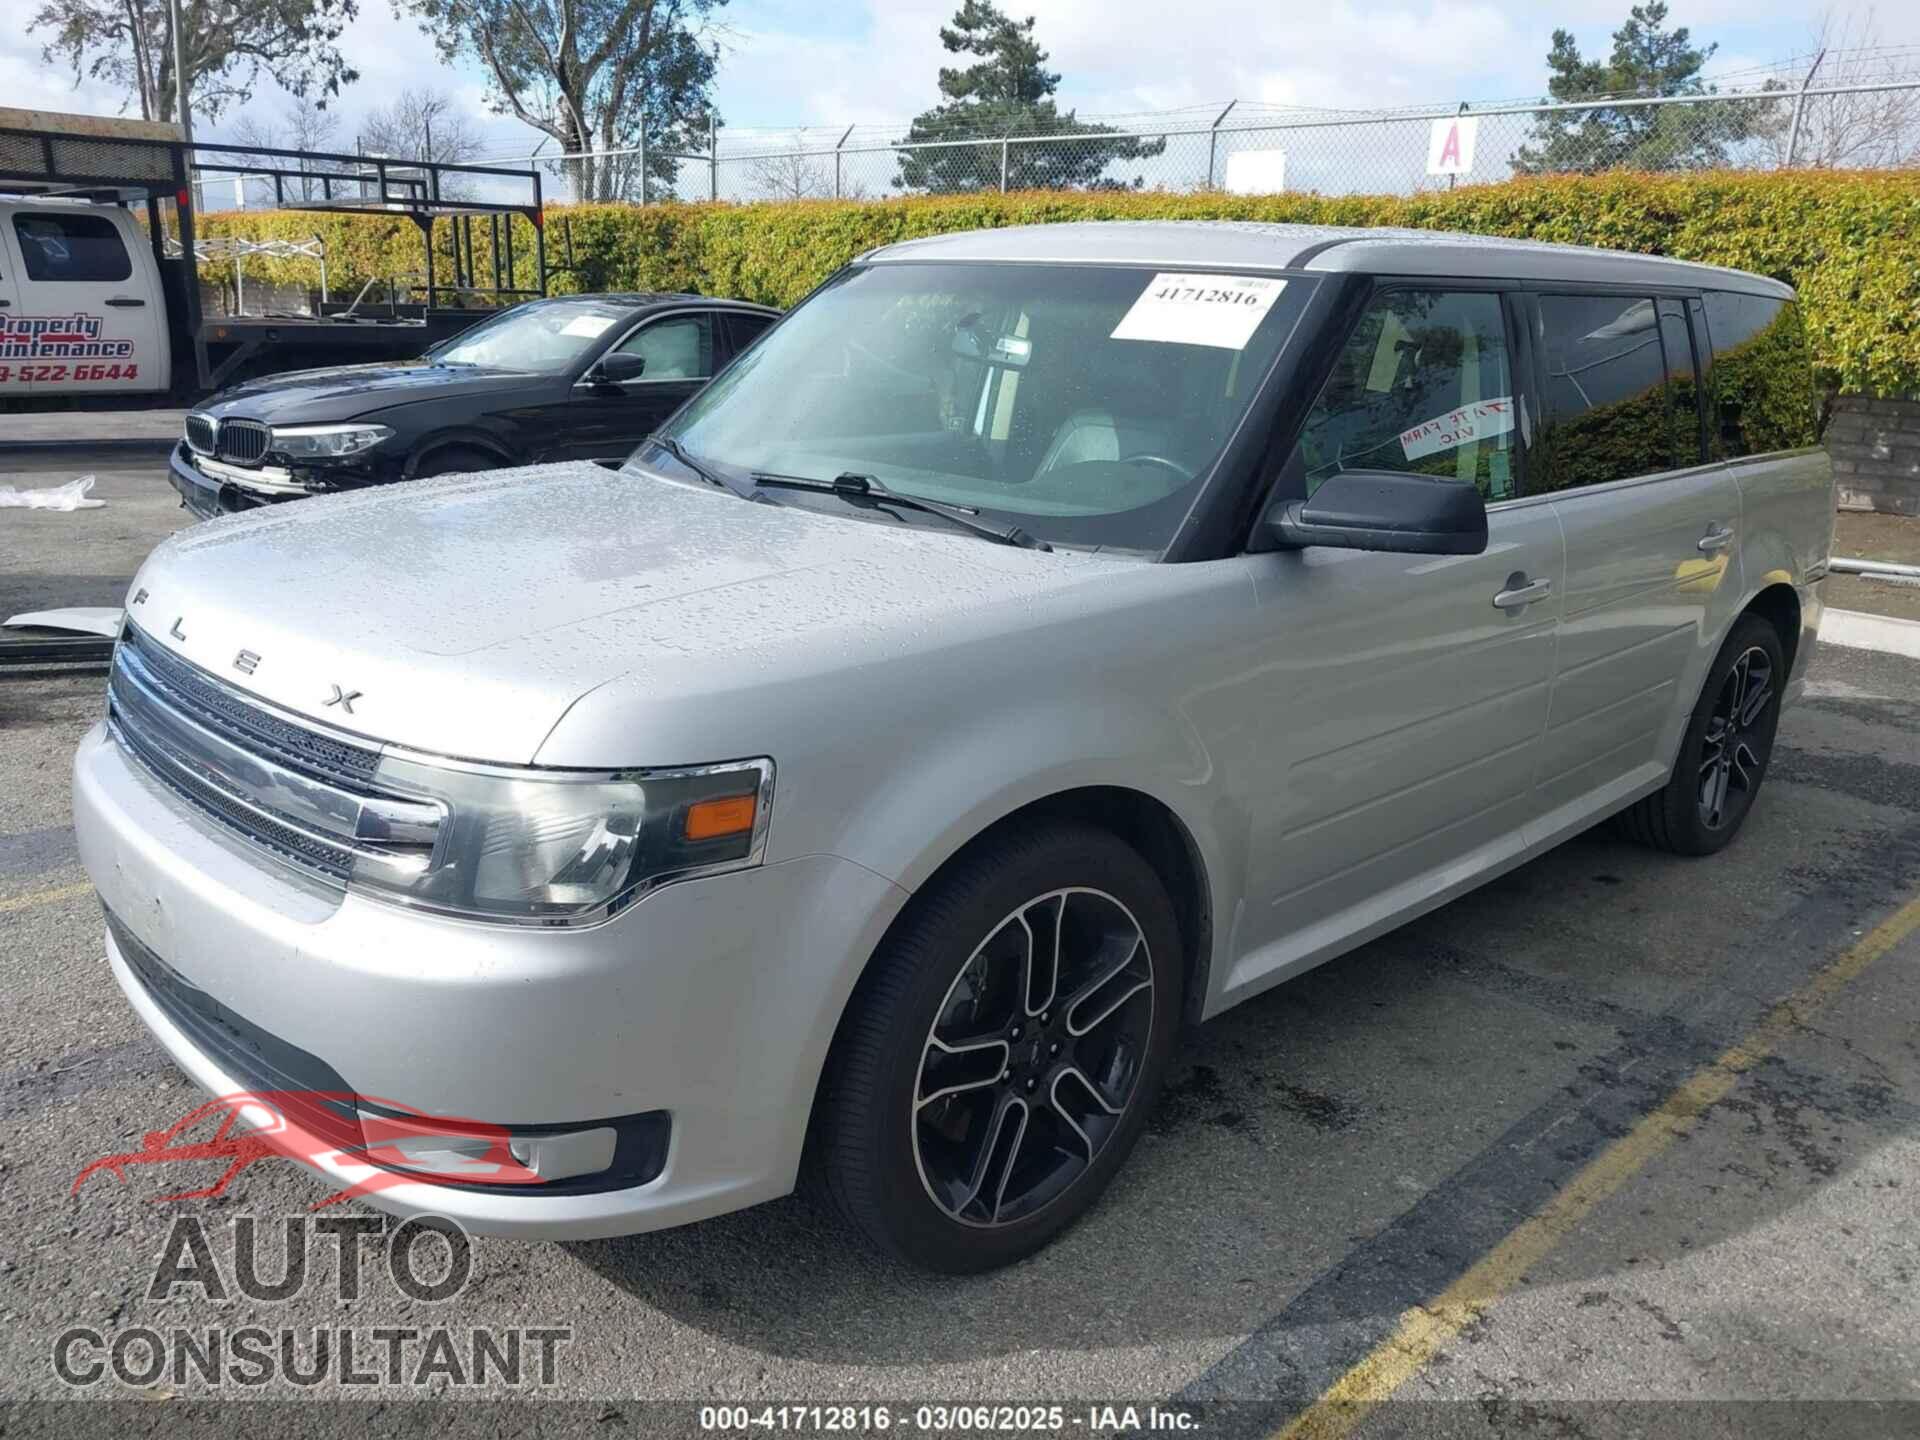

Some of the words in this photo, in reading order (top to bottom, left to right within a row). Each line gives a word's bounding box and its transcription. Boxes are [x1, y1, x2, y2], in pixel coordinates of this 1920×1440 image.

[1440, 122, 1461, 167] A
[1156, 287, 1257, 306] 41712816
[0, 340, 130, 357] intenance
